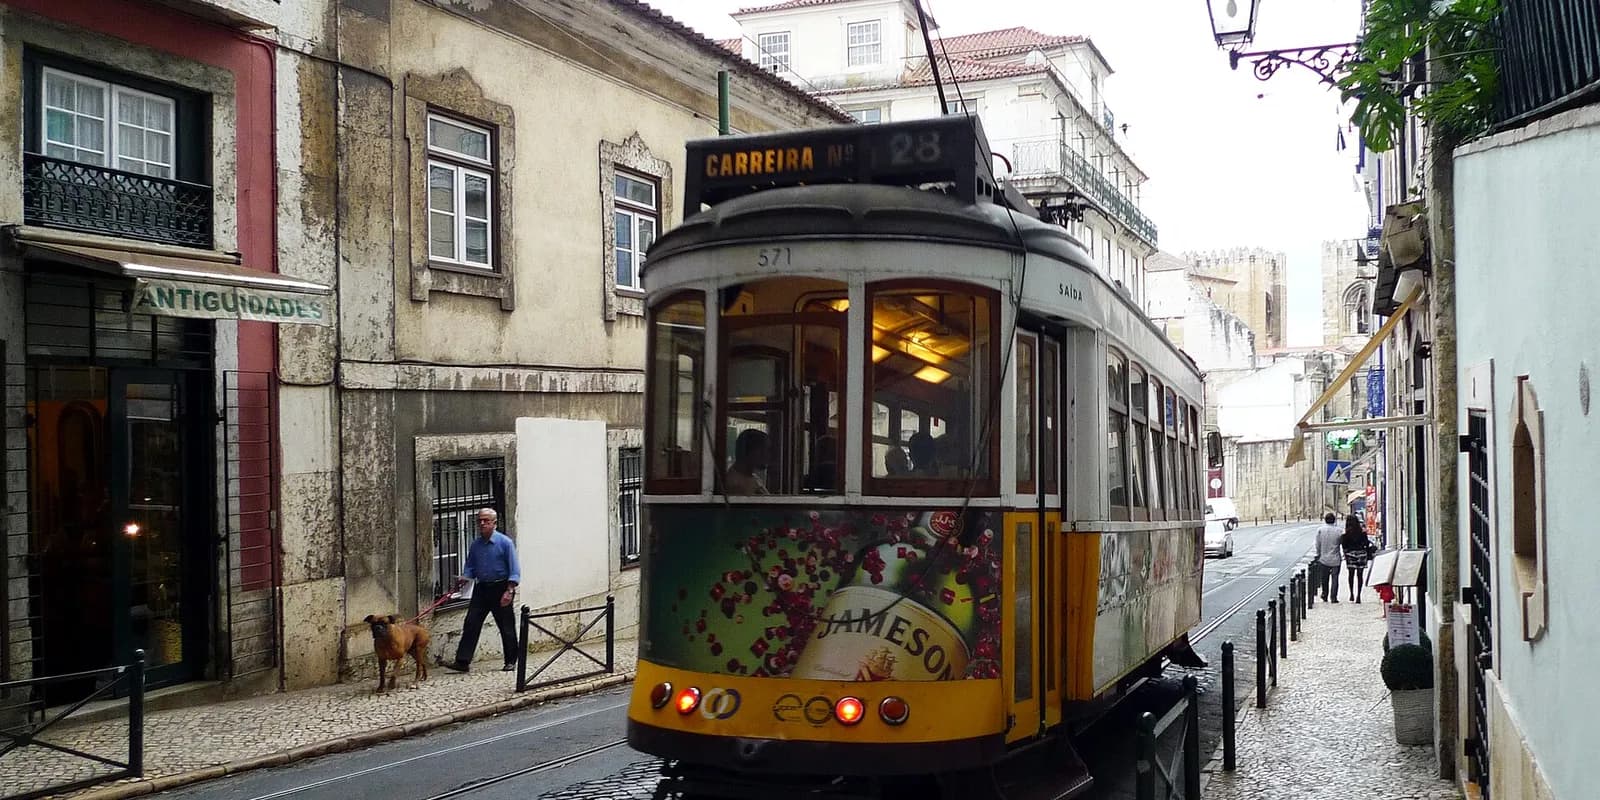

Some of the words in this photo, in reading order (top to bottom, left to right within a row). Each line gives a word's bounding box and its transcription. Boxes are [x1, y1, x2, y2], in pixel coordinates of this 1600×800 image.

[705, 146, 814, 177] CARREIRA
[889, 131, 943, 165] 28
[758, 247, 791, 267] 571
[137, 287, 323, 320] ANTIGUIDADES
[1059, 282, 1083, 302] SAÍDA
